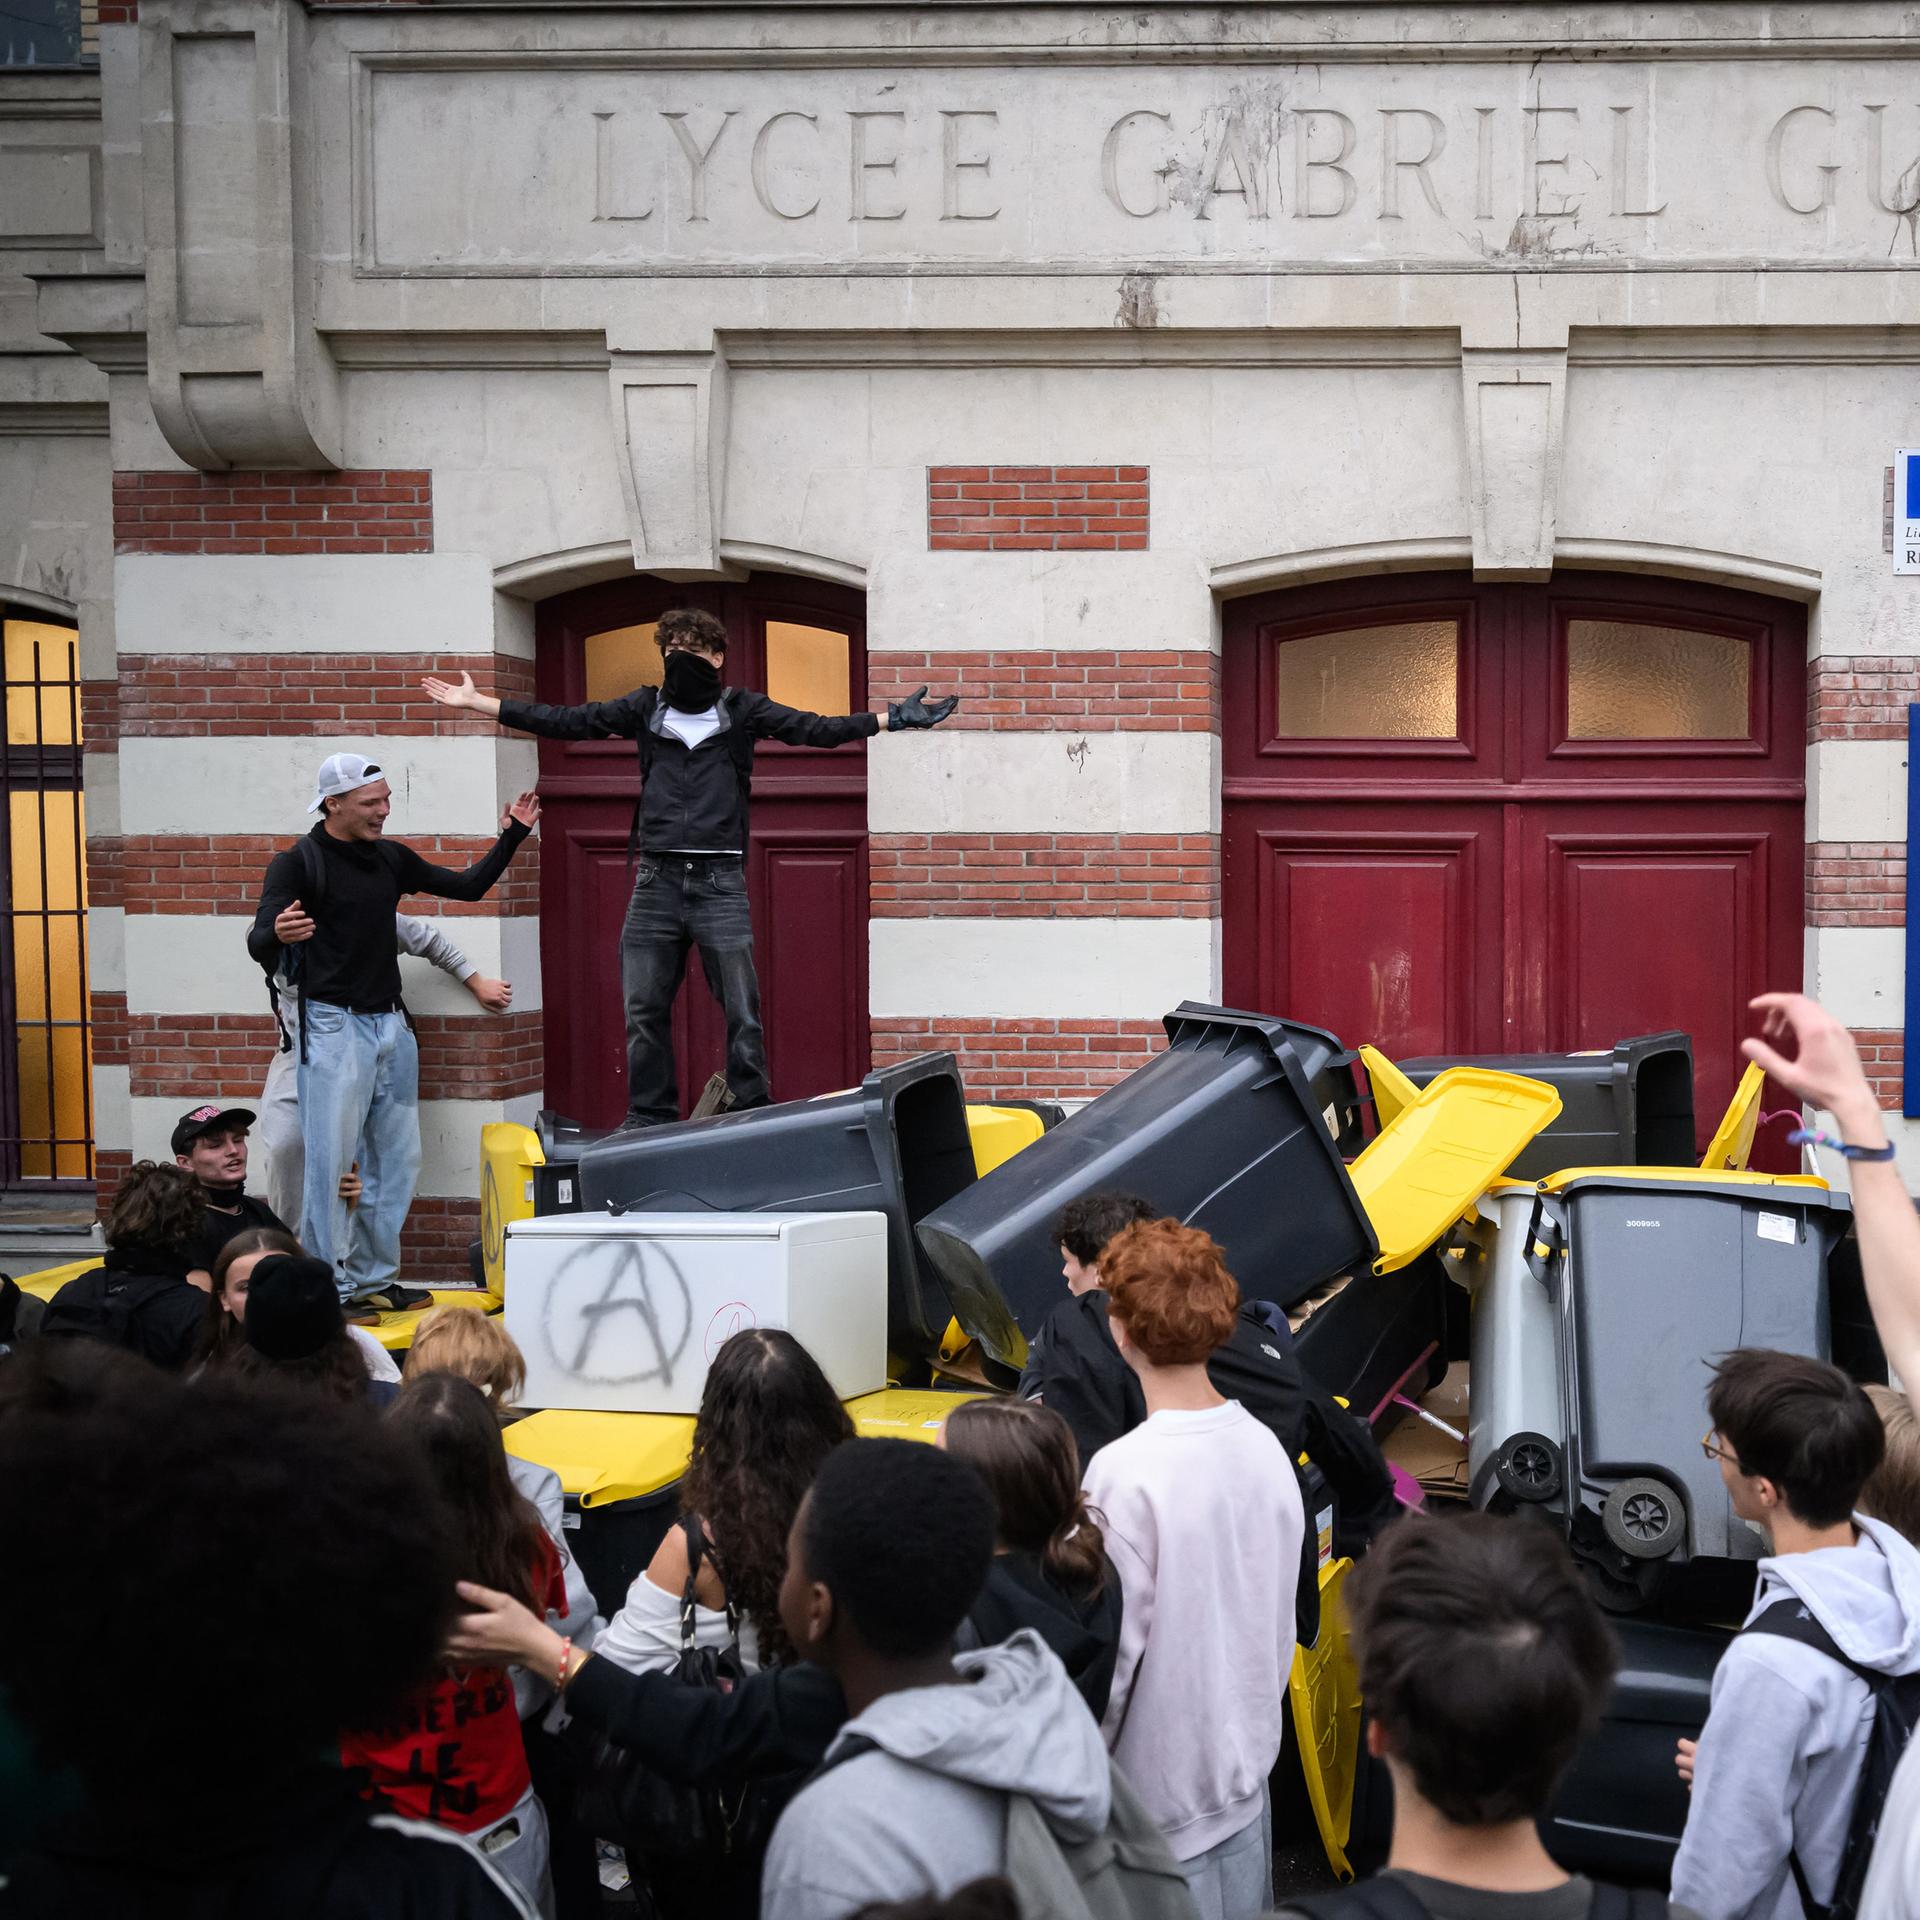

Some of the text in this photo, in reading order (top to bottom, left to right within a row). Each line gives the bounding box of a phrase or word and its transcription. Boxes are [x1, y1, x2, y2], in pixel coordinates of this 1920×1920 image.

[1101, 105, 1668, 221] GABRIEL
[1905, 526, 1920, 538] Li
[1906, 550, 1920, 564] R
